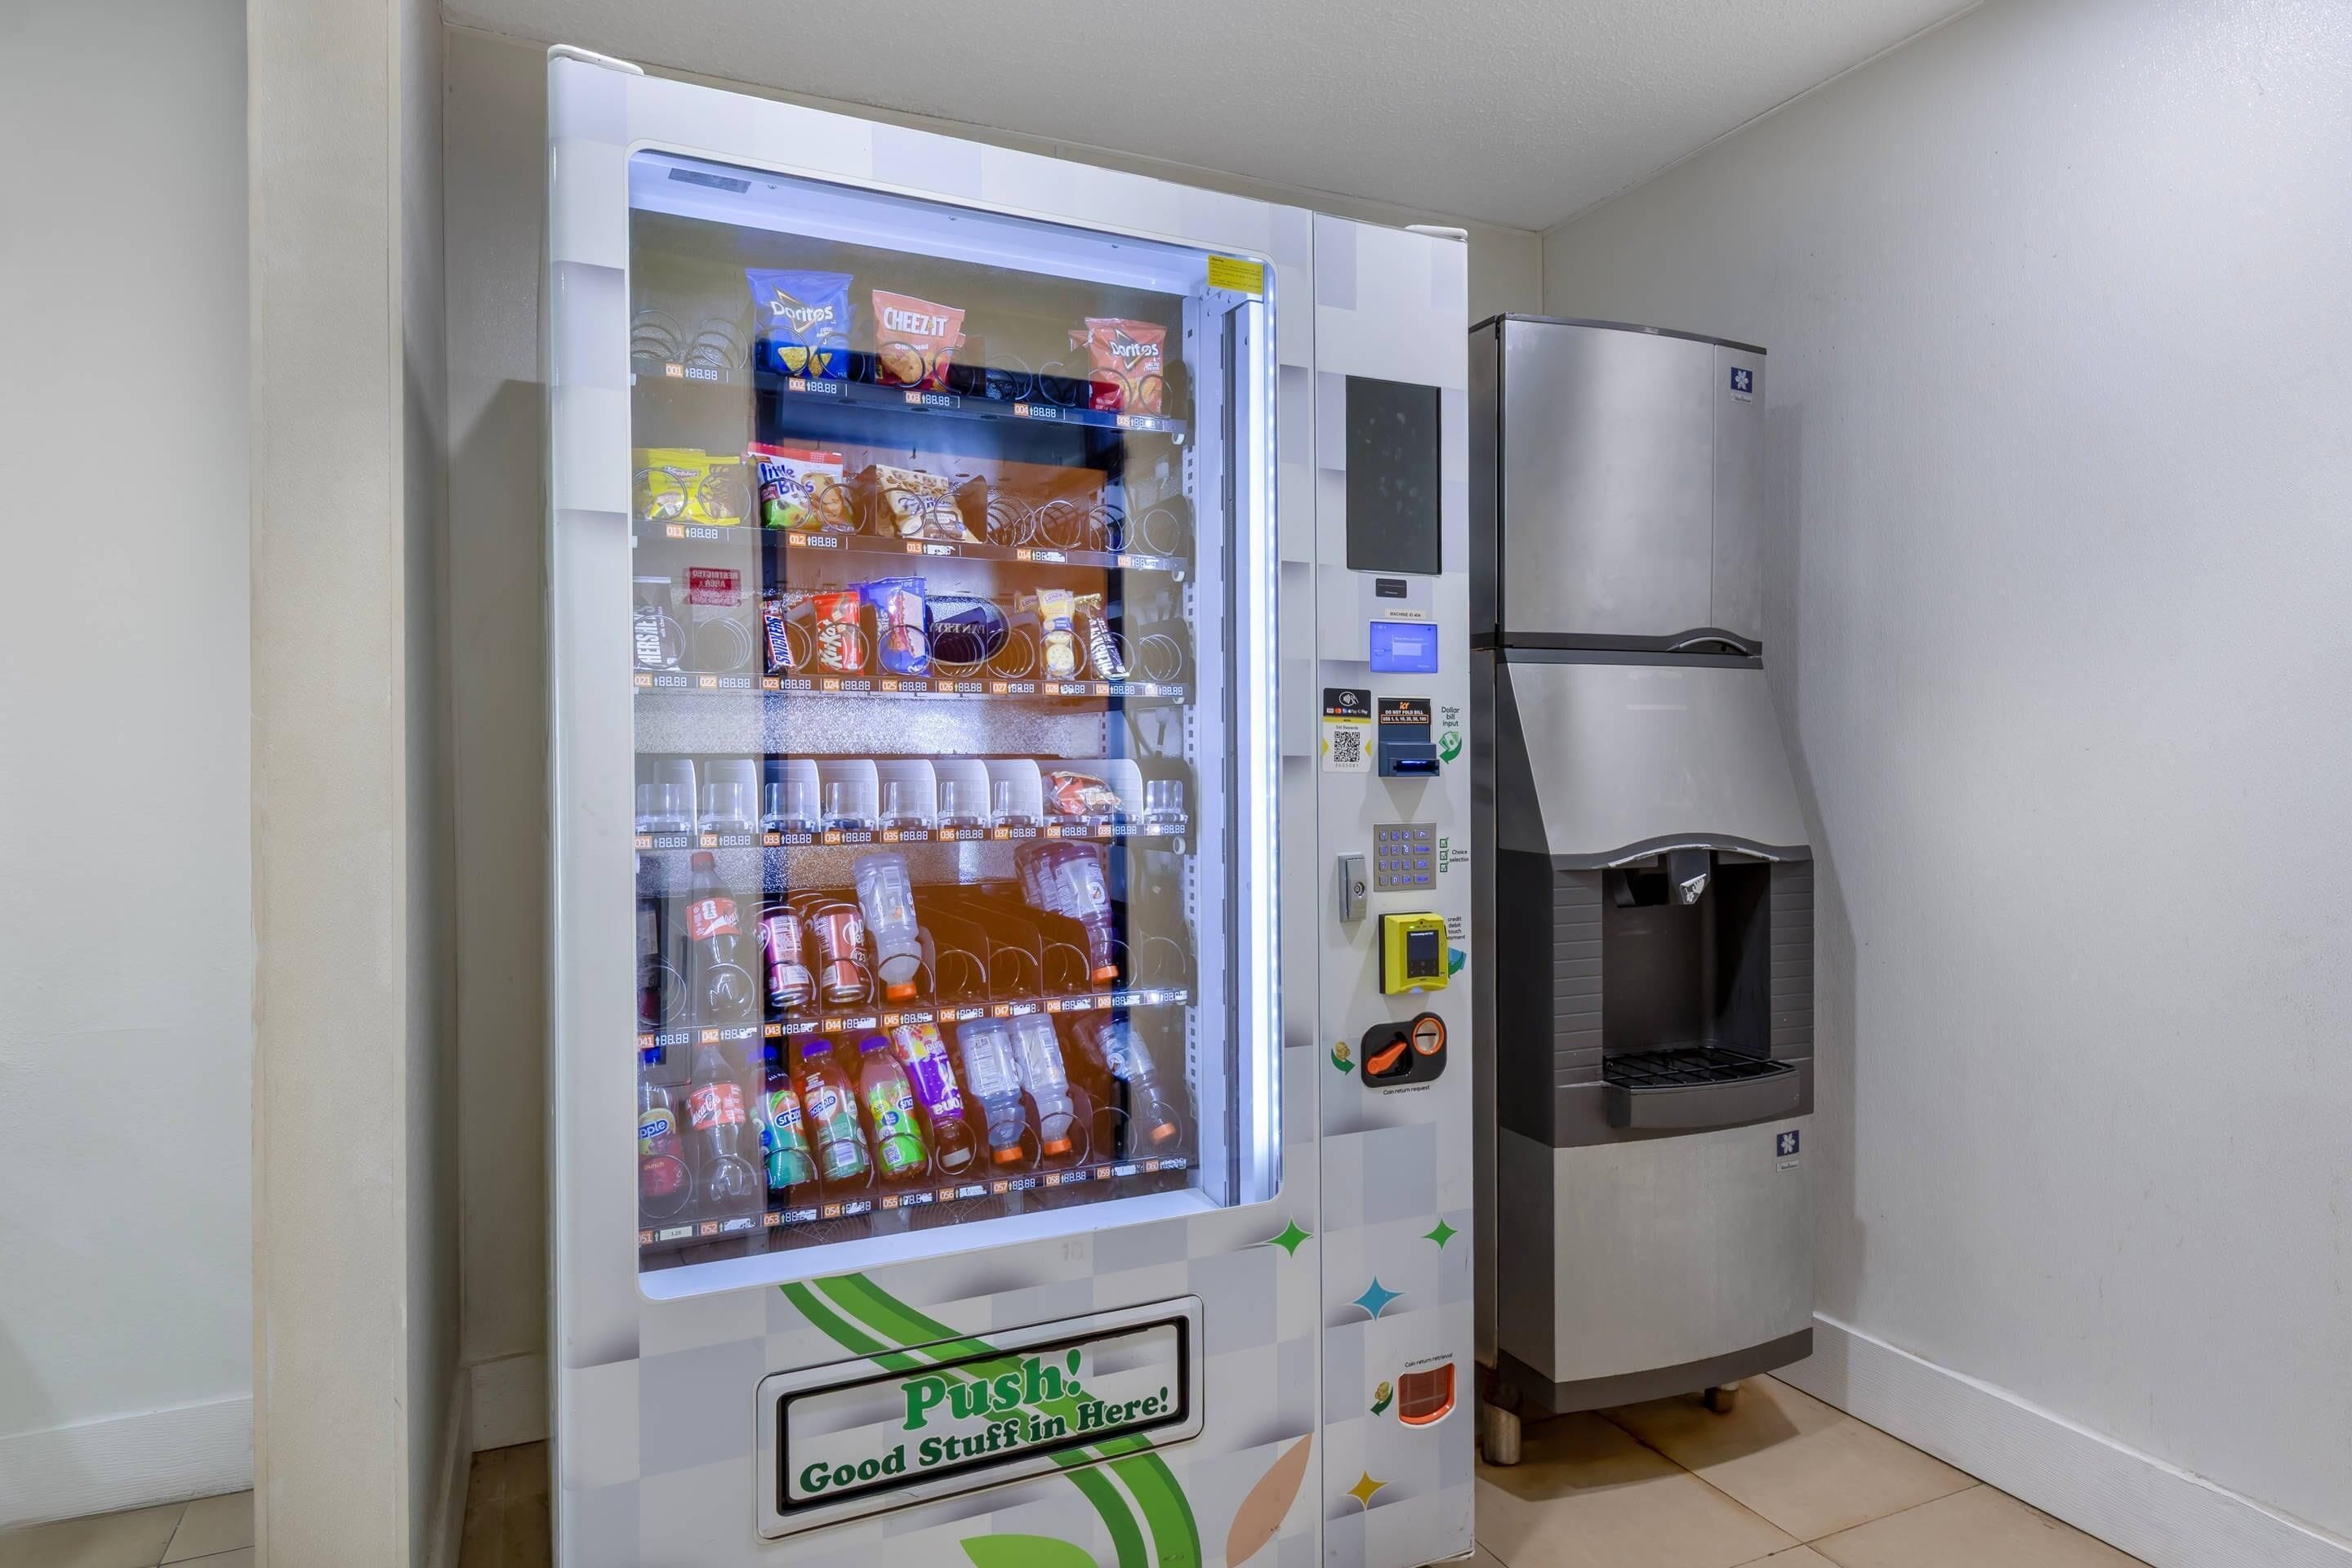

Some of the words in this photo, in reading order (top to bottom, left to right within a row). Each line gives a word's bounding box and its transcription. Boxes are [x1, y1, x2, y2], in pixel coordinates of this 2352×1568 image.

[771, 301, 833, 322] Doritos
[1110, 340, 1158, 358] Doritos
[666, 366, 683, 376] 001
[790, 379, 805, 390] 002
[906, 393, 920, 403] 003
[1014, 405, 1029, 415] 004
[666, 528, 683, 537] 011
[790, 536, 804, 545] 012
[907, 543, 920, 552] 013
[1018, 550, 1031, 559] 014
[766, 616, 791, 666] SNICKERS
[635, 677, 651, 687] 021
[700, 677, 716, 687] 022
[764, 679, 778, 688] 023
[824, 679, 839, 689] 024
[883, 681, 897, 690] 025
[939, 683, 953, 692] 026
[993, 683, 1006, 693] 027
[884, 831, 898, 840] 035
[941, 831, 955, 840] 036
[995, 830, 1008, 838] 037
[1047, 829, 1060, 837] 038
[700, 837, 715, 845] 032
[764, 835, 779, 844] 033
[825, 834, 840, 842] 034
[1047, 1002, 1061, 1011] 048
[1098, 998, 1111, 1007] 049
[941, 1010, 955, 1020] 046
[995, 1007, 1009, 1016] 047
[884, 1015, 898, 1025] 045
[826, 1021, 841, 1030] 044
[765, 1027, 780, 1036] 043
[702, 1032, 718, 1041] 042
[1147, 1161, 1159, 1170] 060
[1098, 1168, 1111, 1177] 059
[1047, 1175, 1060, 1184] 058
[994, 1183, 1008, 1192] 057
[940, 1190, 955, 1199] 056
[884, 1198, 898, 1208] 055
[825, 1206, 840, 1215] 054
[764, 1214, 779, 1223] 053
[701, 1223, 717, 1233] 052
[1416, 1357, 1432, 1365] return
[902, 1348, 1082, 1431] Push!
[800, 1446, 906, 1493] Good
[919, 1417, 1020, 1467] Stuff
[1028, 1413, 1065, 1443] in
[1078, 1386, 1169, 1431] Here!
